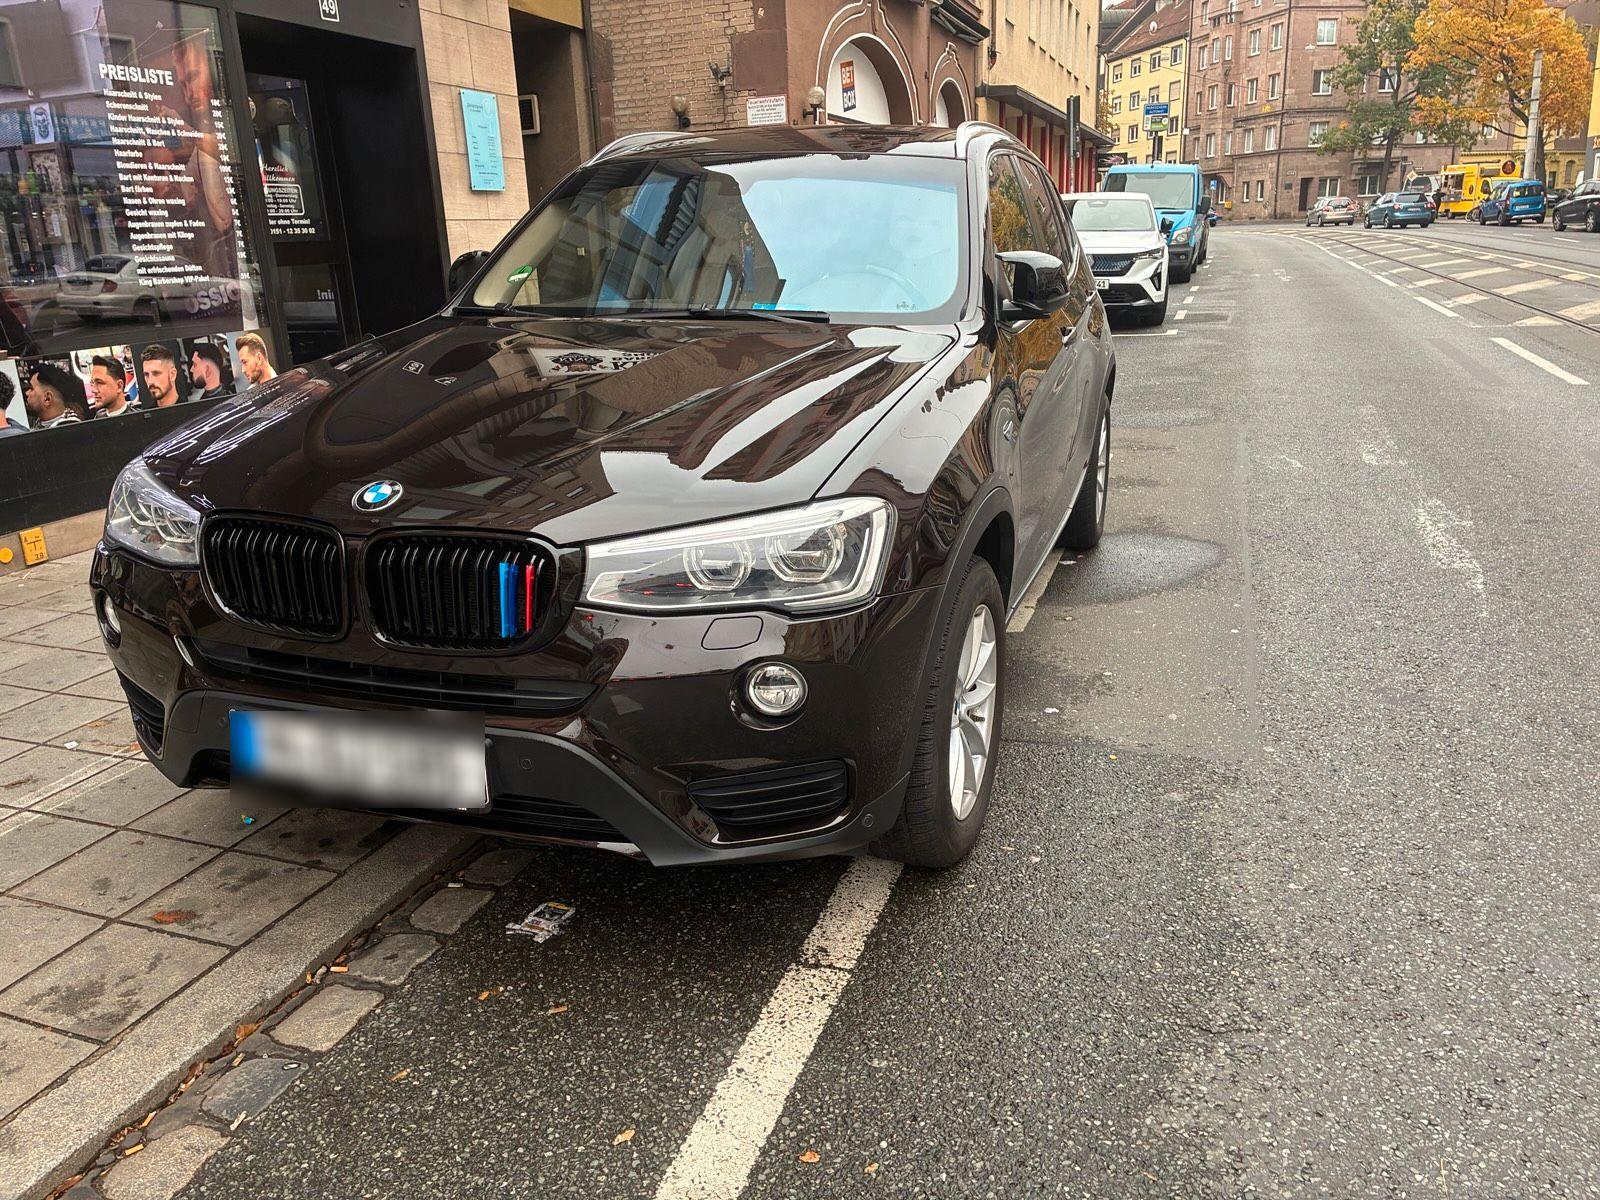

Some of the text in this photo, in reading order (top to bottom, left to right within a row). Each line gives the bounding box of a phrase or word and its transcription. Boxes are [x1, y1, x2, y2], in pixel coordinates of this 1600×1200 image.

[322, 0, 336, 14] 49
[99, 64, 173, 86] PREISLISTE
[842, 65, 854, 84] BET
[104, 88, 137, 98] Haarschnitt
[145, 92, 162, 101] Stylen
[843, 91, 856, 108] BOX
[106, 101, 149, 111] Scherenschnitt
[108, 113, 127, 121] Kinder
[128, 114, 161, 124] Haarschnitt
[167, 118, 184, 126] Stylen
[110, 125, 145, 135] Haarschnitt,
[146, 128, 170, 136] Waschen
[177, 130, 204, 138] Schneiden
[112, 137, 145, 146] Haarschnitt
[114, 149, 143, 158] Haarfarbe
[117, 161, 147, 170] Blondieren
[154, 163, 185, 171] Haarschnitt
[119, 173, 132, 181] Bart
[143, 174, 168, 182] Konturen
[123, 197, 142, 205] Nasen
[166, 198, 186, 206] waxing
[148, 209, 168, 217] waxing
[128, 221, 164, 229] Augenbrauen
[130, 232, 166, 241] Augenbrauen
[132, 244, 173, 252] Gesichtspflege
[147, 266, 184, 274] erfrischenden
[185, 264, 202, 272] Düften
[154, 277, 184, 285] Barbershop
[185, 275, 209, 283] VIP-Paket
